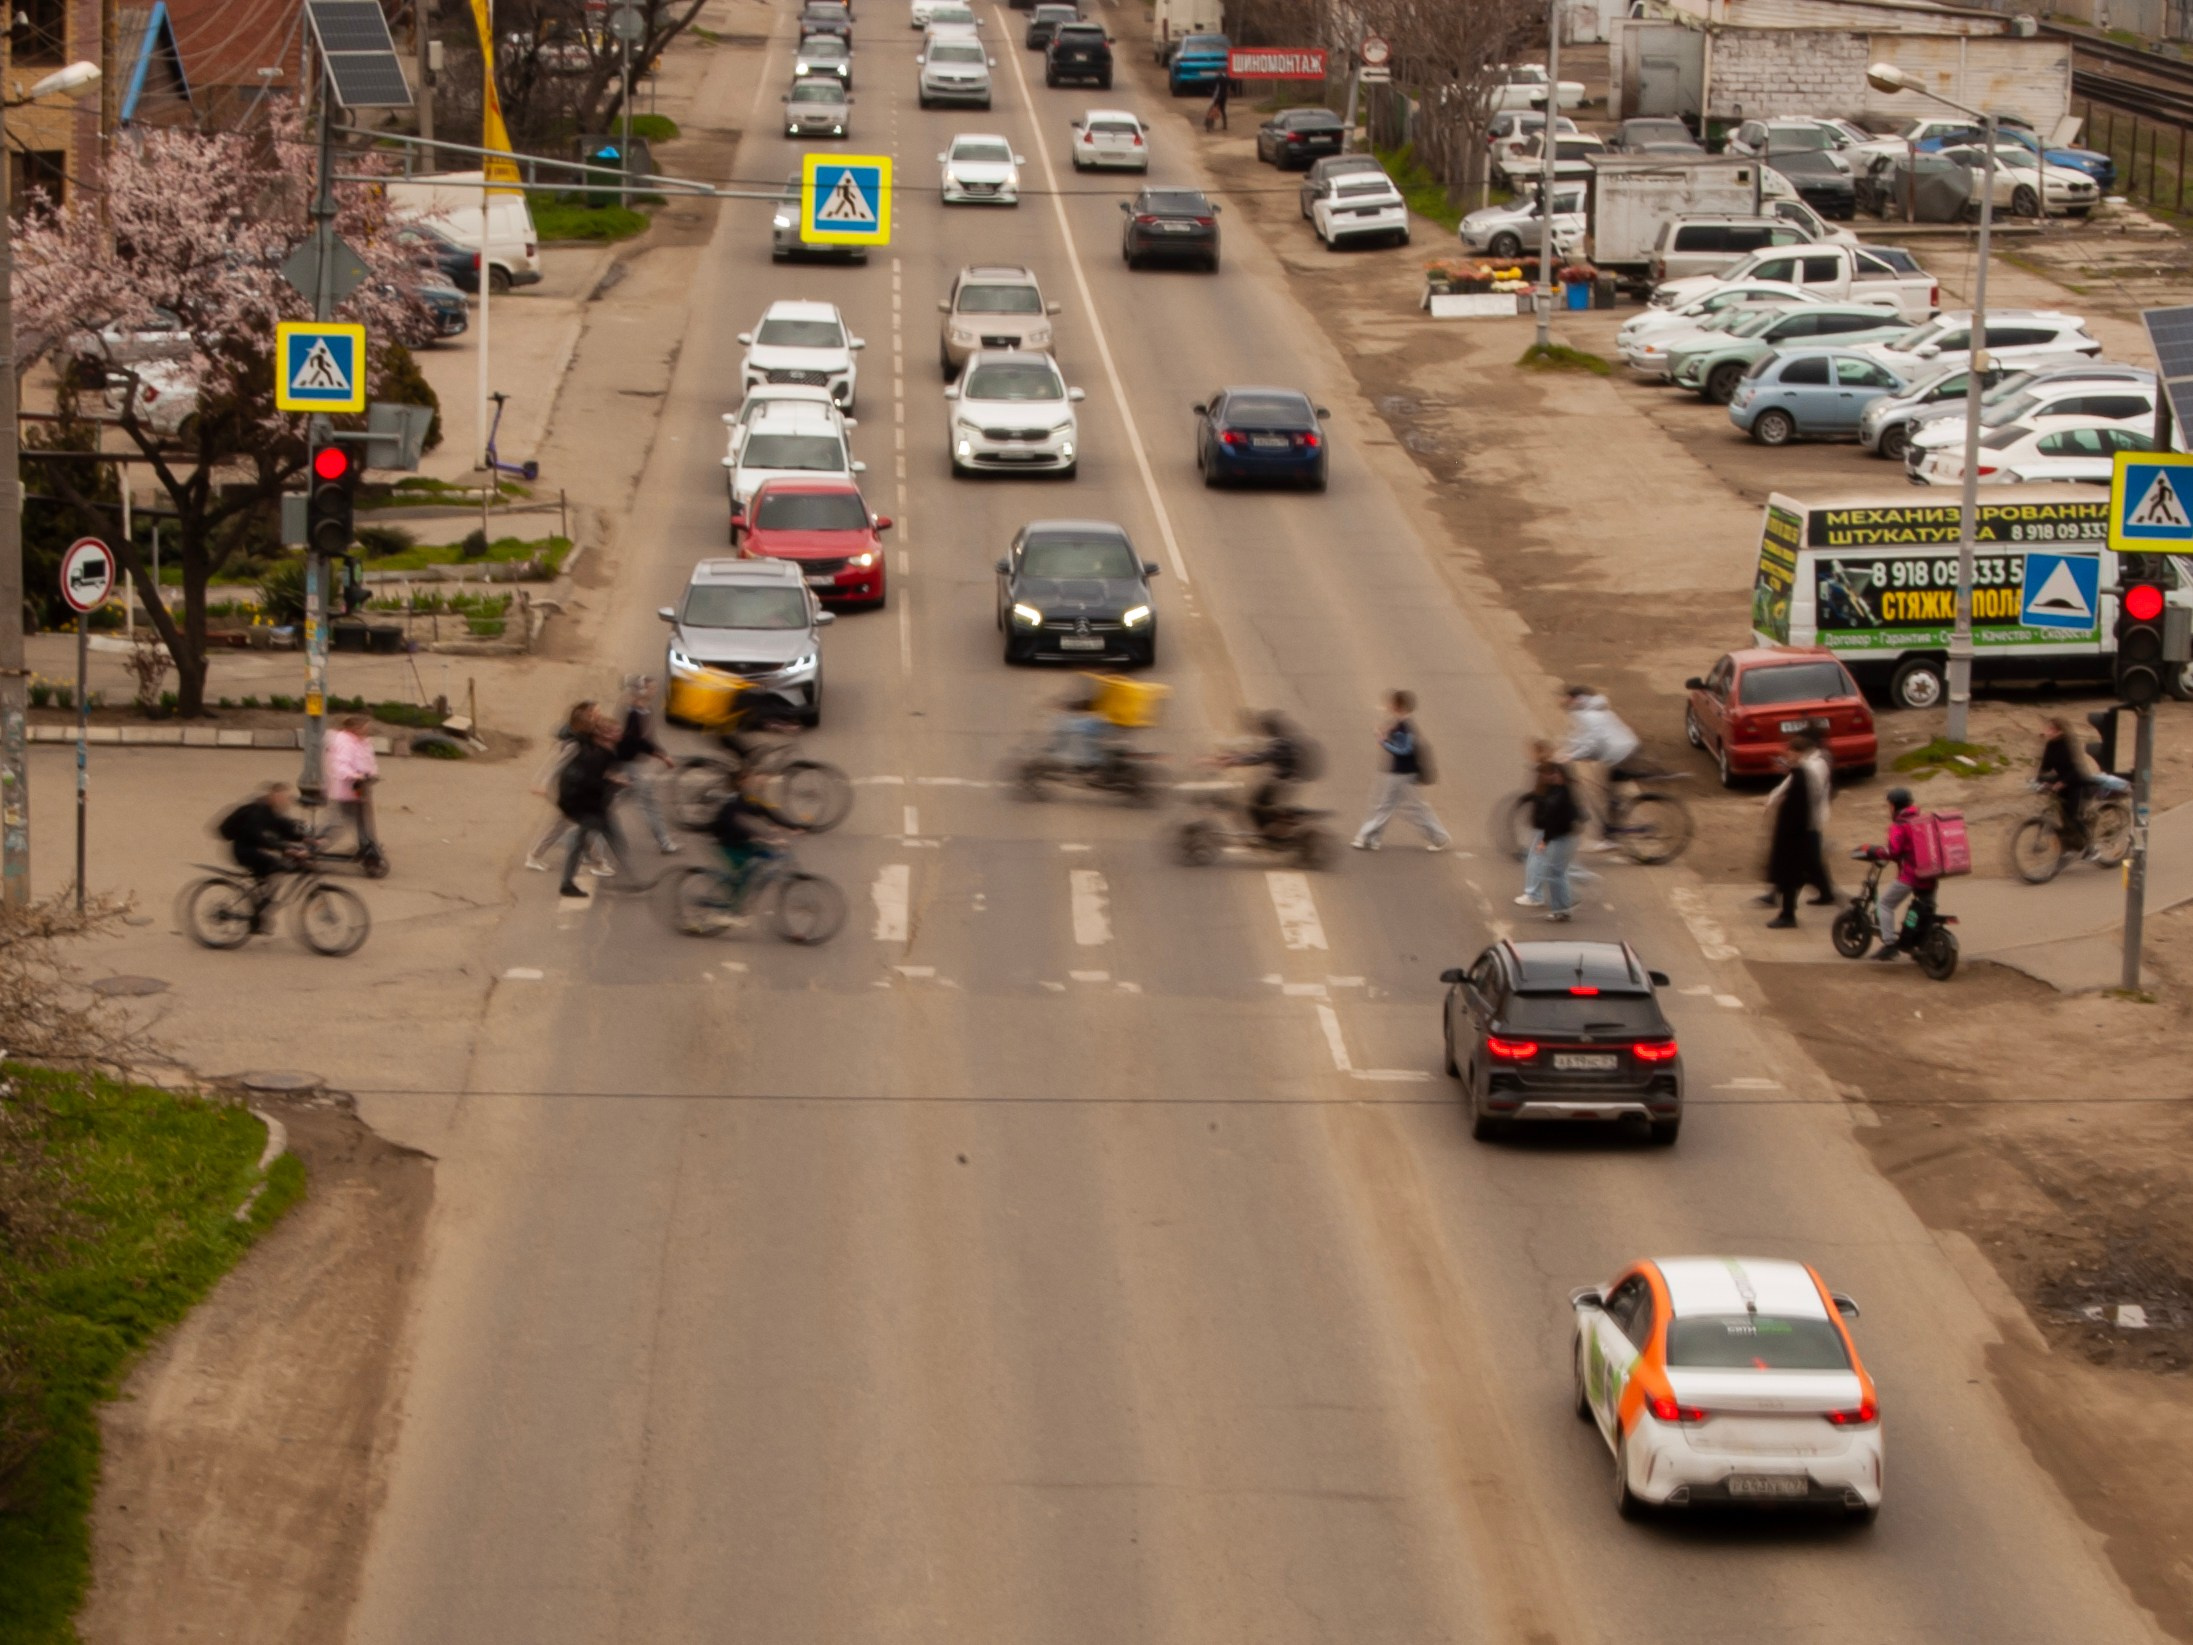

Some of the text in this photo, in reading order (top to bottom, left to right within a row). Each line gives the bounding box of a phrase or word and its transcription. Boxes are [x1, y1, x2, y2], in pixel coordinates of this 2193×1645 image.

[1232, 53, 1323, 74] ШИНОМОНТАЖ
[1828, 526, 1996, 545] ШТУКАТУРА
[2011, 524, 2023, 541] 8
[2026, 524, 2054, 541] 918
[2056, 523, 2079, 540] 09
[1872, 562, 1887, 587] 8
[1891, 561, 1929, 587] 918
[1933, 560, 1960, 586] 09
[2009, 558, 2024, 584] 5
